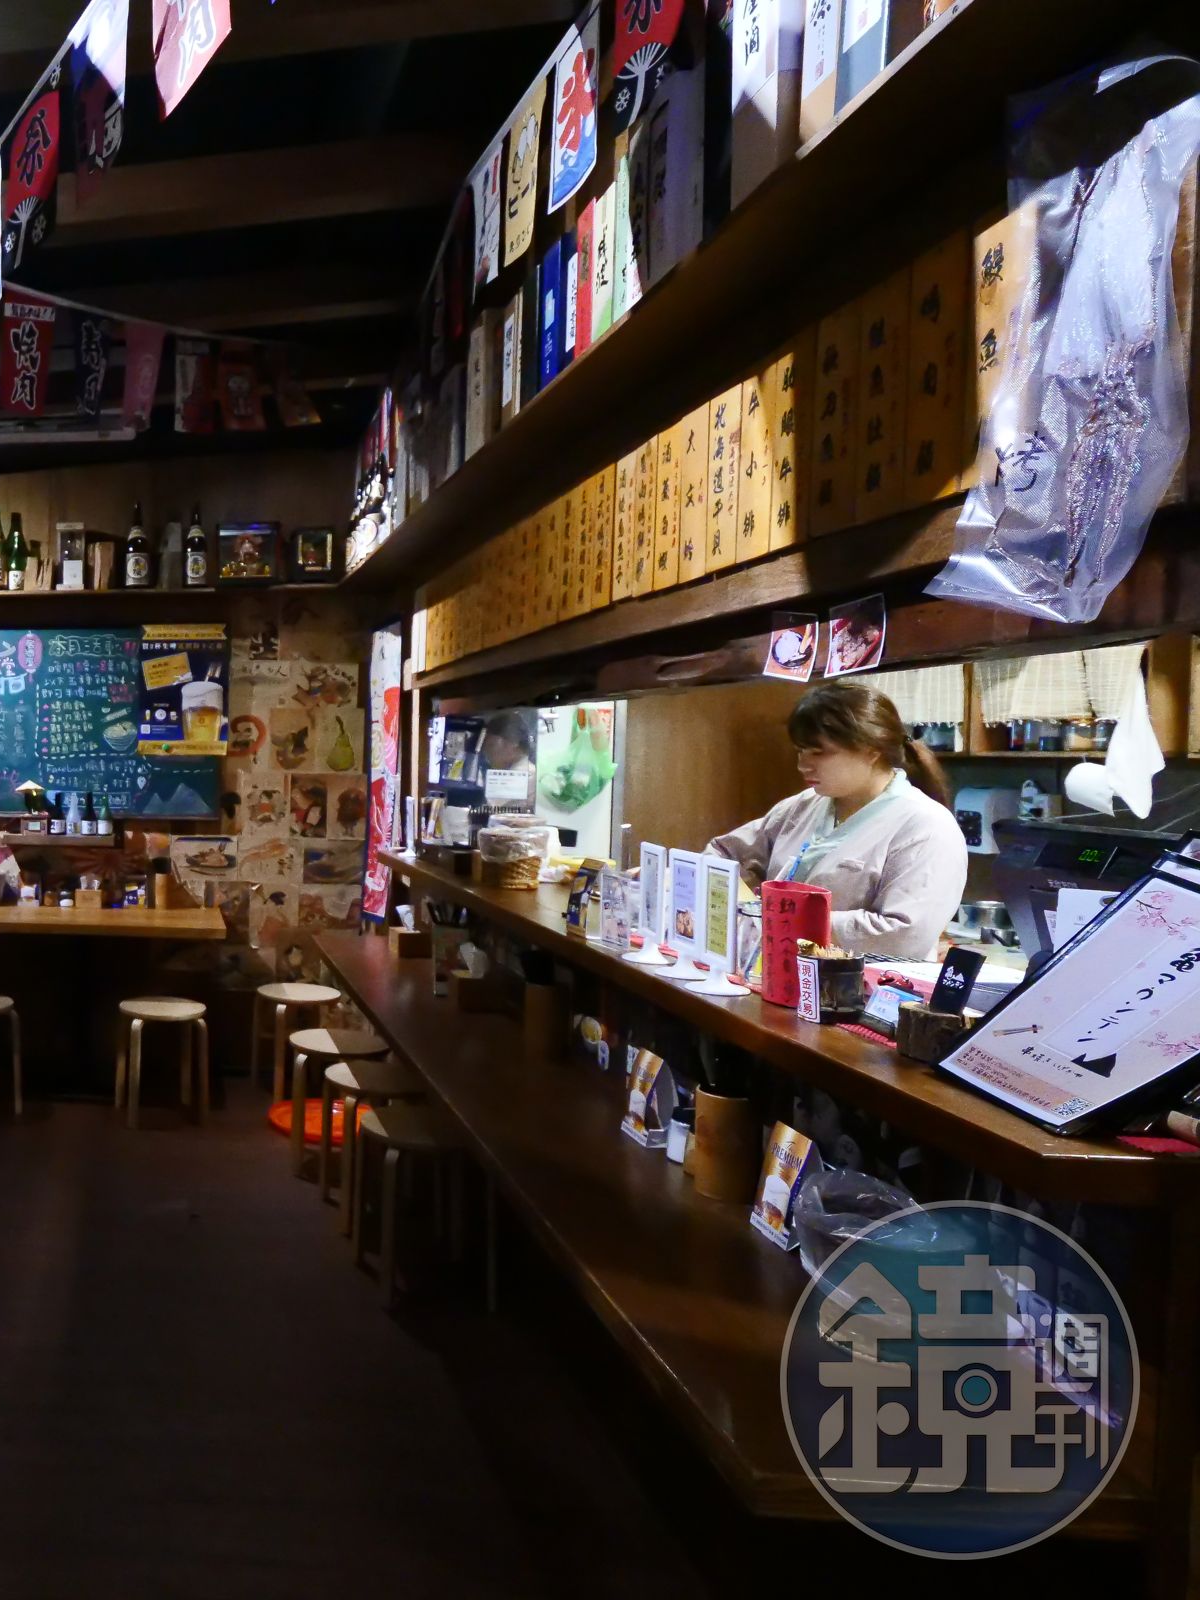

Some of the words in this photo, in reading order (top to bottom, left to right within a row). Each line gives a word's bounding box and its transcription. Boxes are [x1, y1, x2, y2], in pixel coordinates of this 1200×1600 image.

[743, 389, 760, 537] 牛小排
[802, 964, 813, 1016] 現金交易
